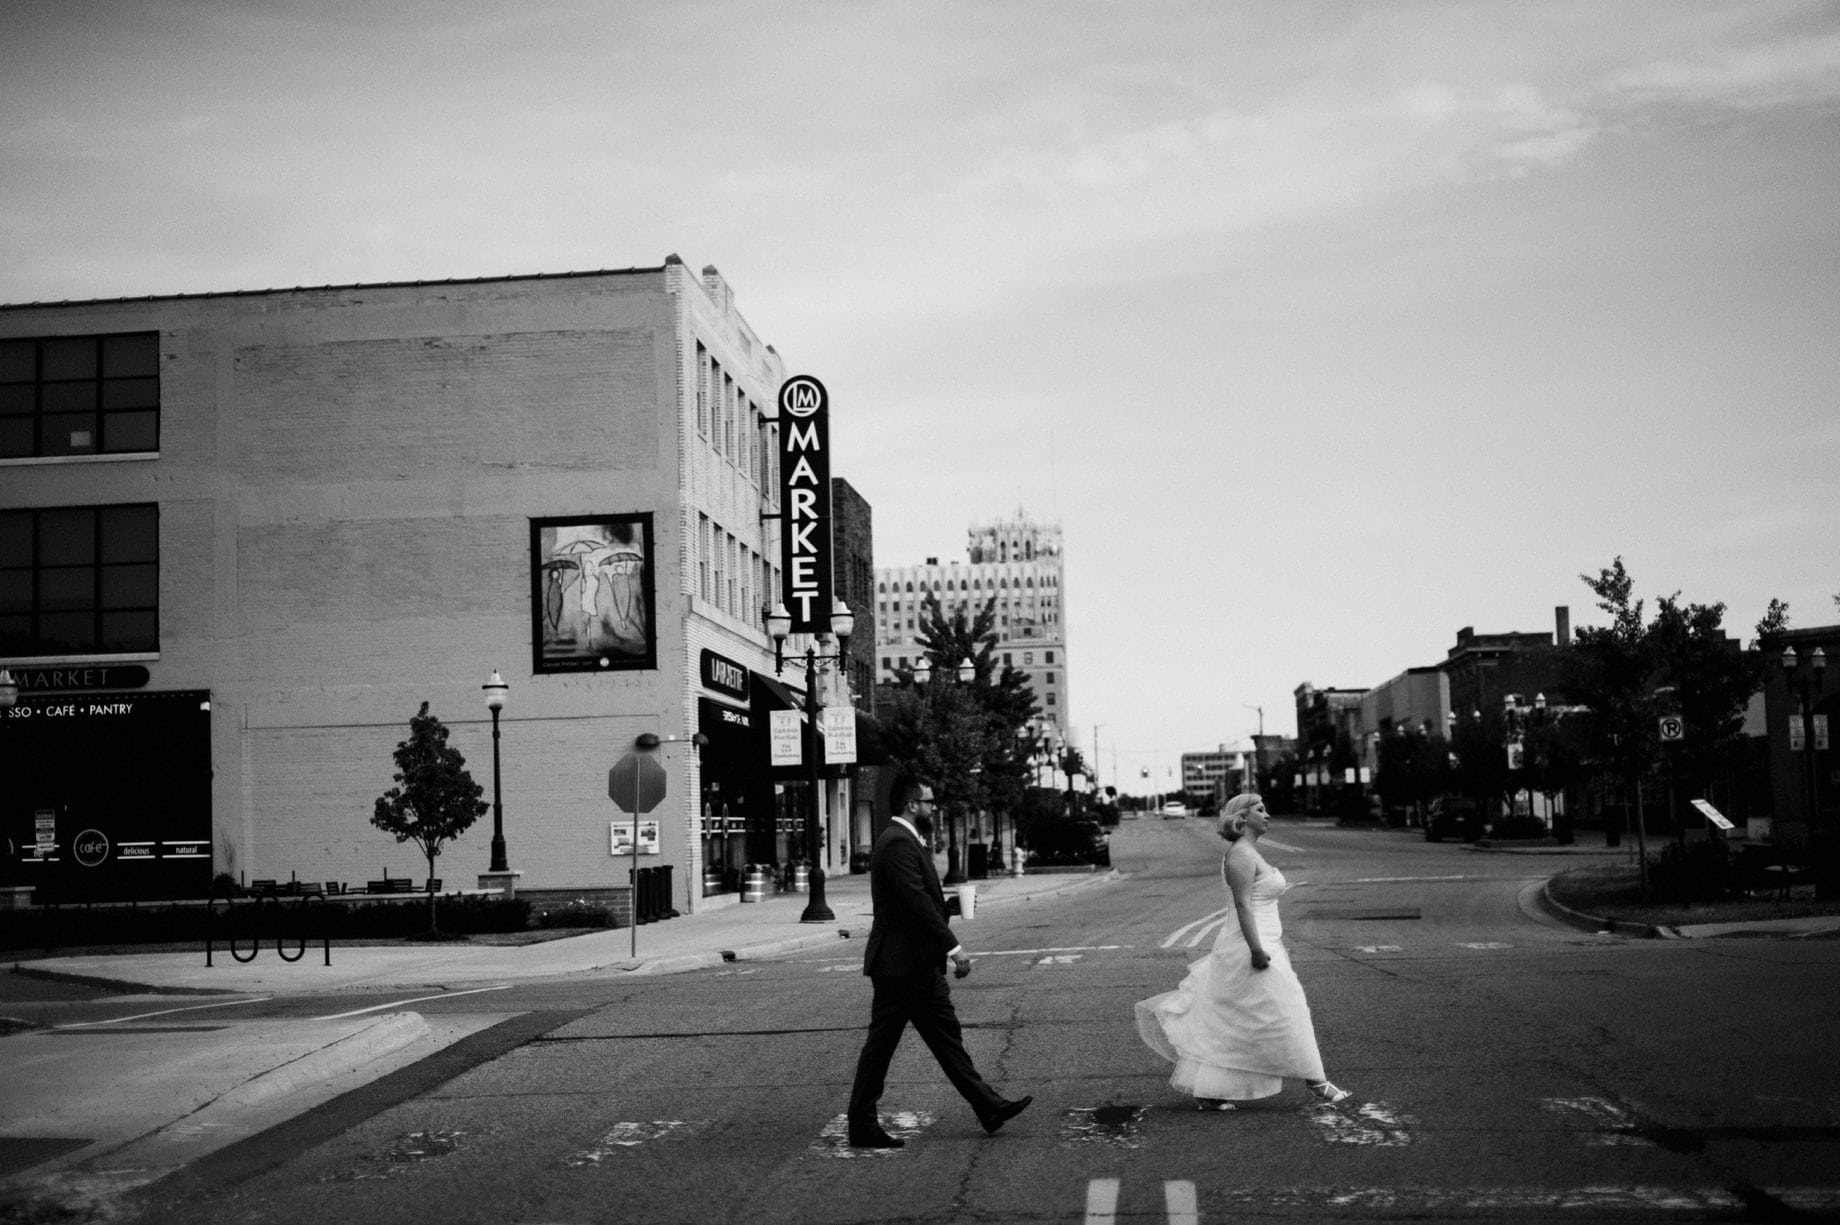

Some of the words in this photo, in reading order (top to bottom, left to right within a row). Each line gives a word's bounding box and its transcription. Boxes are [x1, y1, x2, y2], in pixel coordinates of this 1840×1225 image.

[787, 420, 821, 623] MARKET
[13, 669, 109, 688] MARKET
[711, 658, 743, 691] LAFAYETTE
[0, 706, 32, 719] SSO
[45, 704, 75, 717] CAFÉ
[89, 703, 133, 716] PANTRY
[123, 846, 150, 856] delicious
[175, 845, 198, 855] natural
